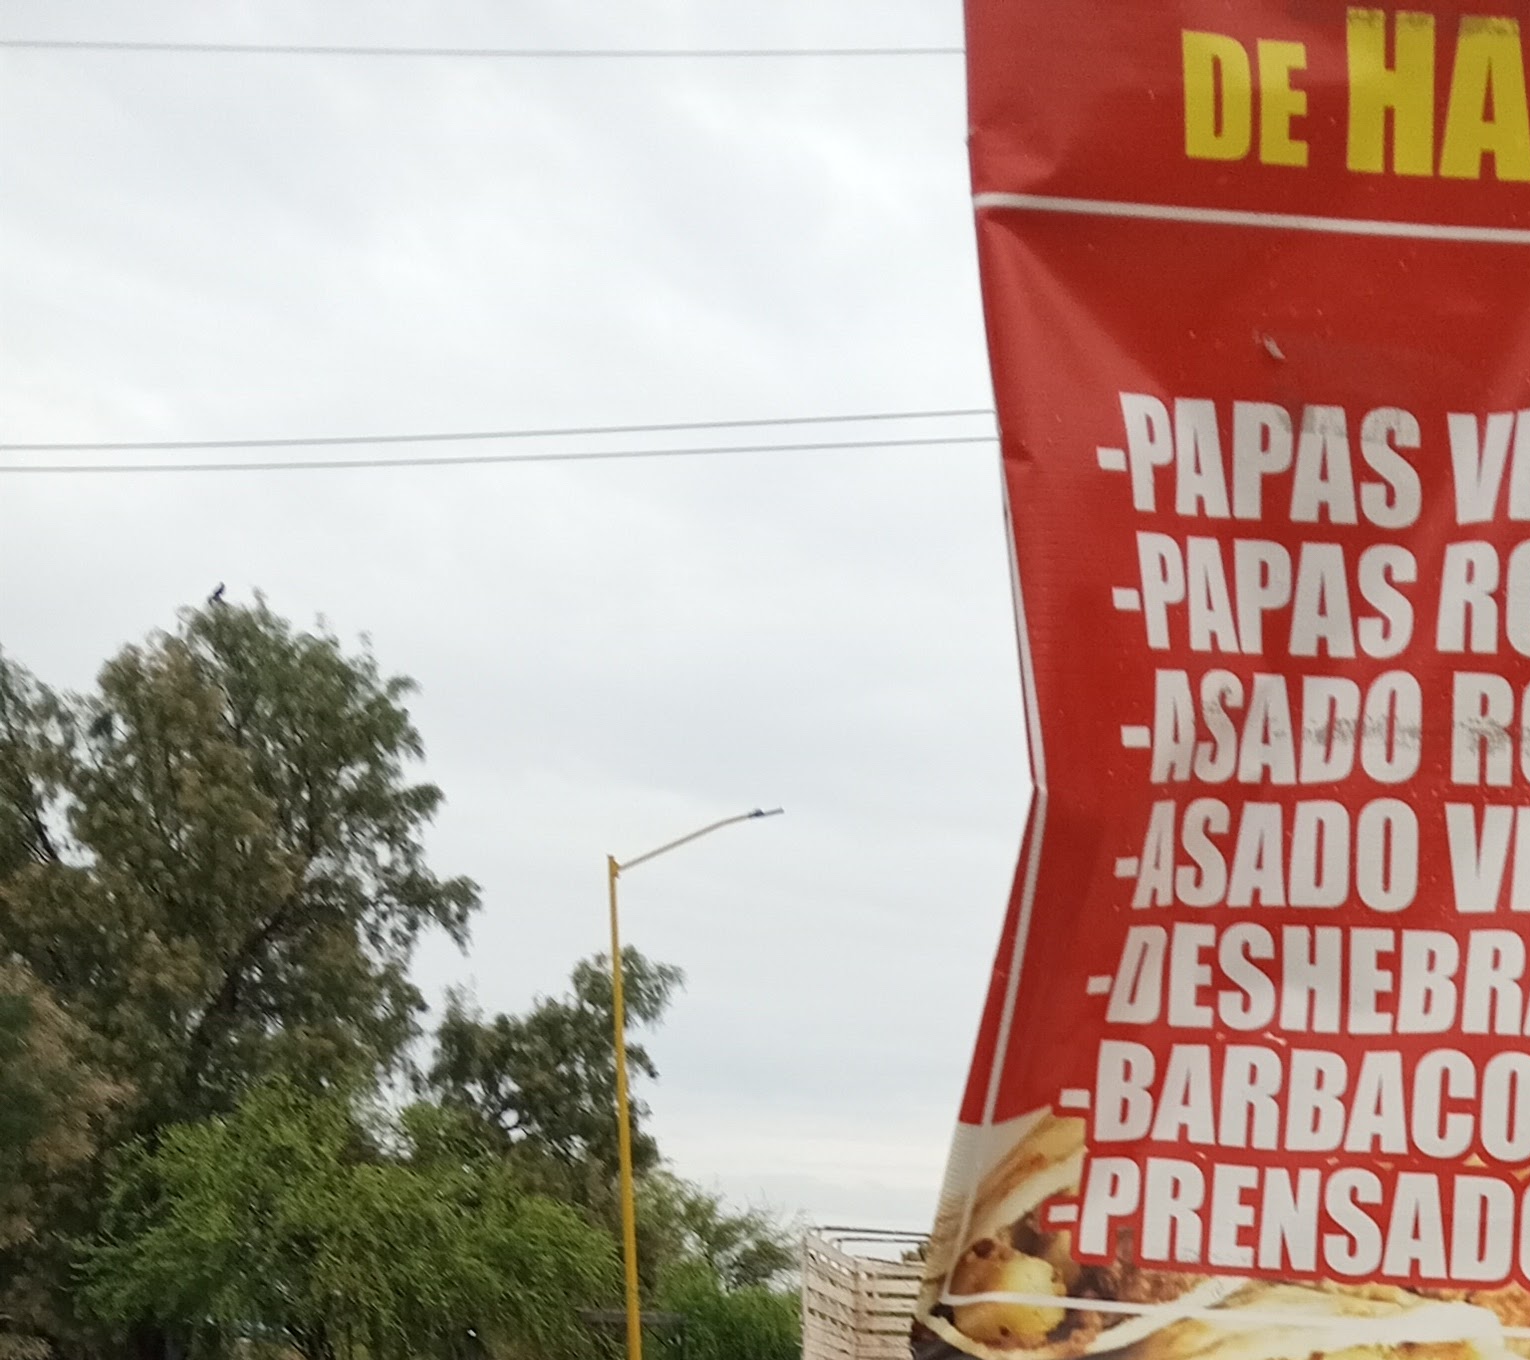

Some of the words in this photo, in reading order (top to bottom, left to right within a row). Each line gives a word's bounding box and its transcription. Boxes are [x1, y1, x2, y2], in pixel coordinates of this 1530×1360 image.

[1183, 31, 1307, 165] DE
[1097, 392, 1421, 528] -PAPAS
[1113, 532, 1416, 658] -PAPAS
[1122, 670, 1422, 785] -ASADO
[1116, 799, 1418, 911] -ASADO
